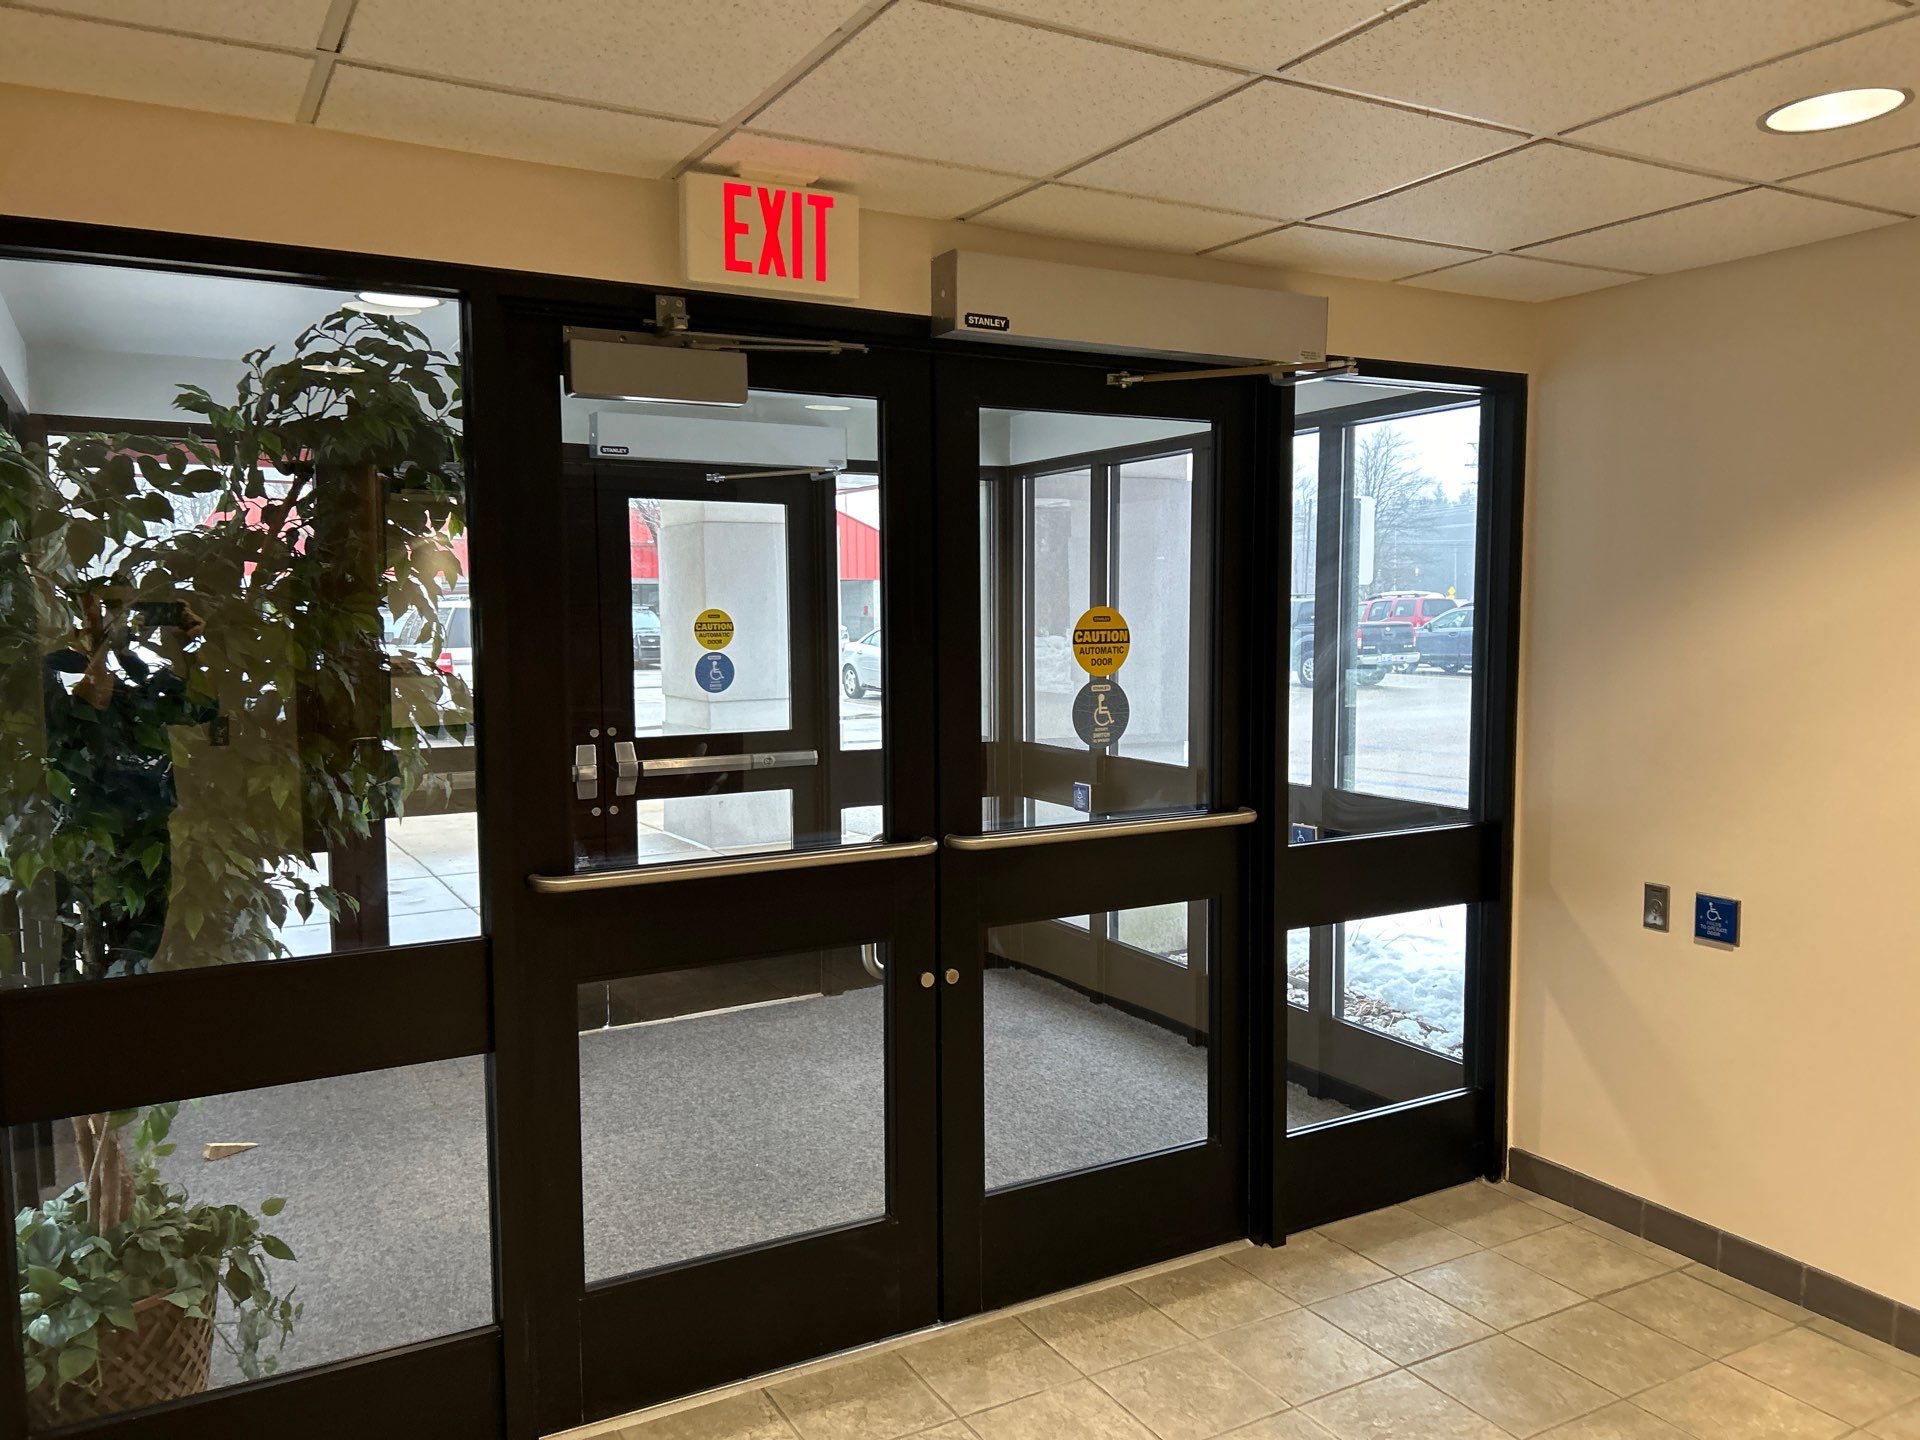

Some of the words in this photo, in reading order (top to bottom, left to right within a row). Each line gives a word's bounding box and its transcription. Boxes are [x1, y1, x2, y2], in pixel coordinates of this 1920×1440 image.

[723, 182, 834, 282] EXIT
[968, 315, 1006, 328] STANLEY
[695, 623, 733, 631] CAUTION
[1074, 630, 1128, 643] CAUTION
[1079, 646, 1124, 655] AUTOMATIC
[1091, 657, 1113, 667] DOOR
